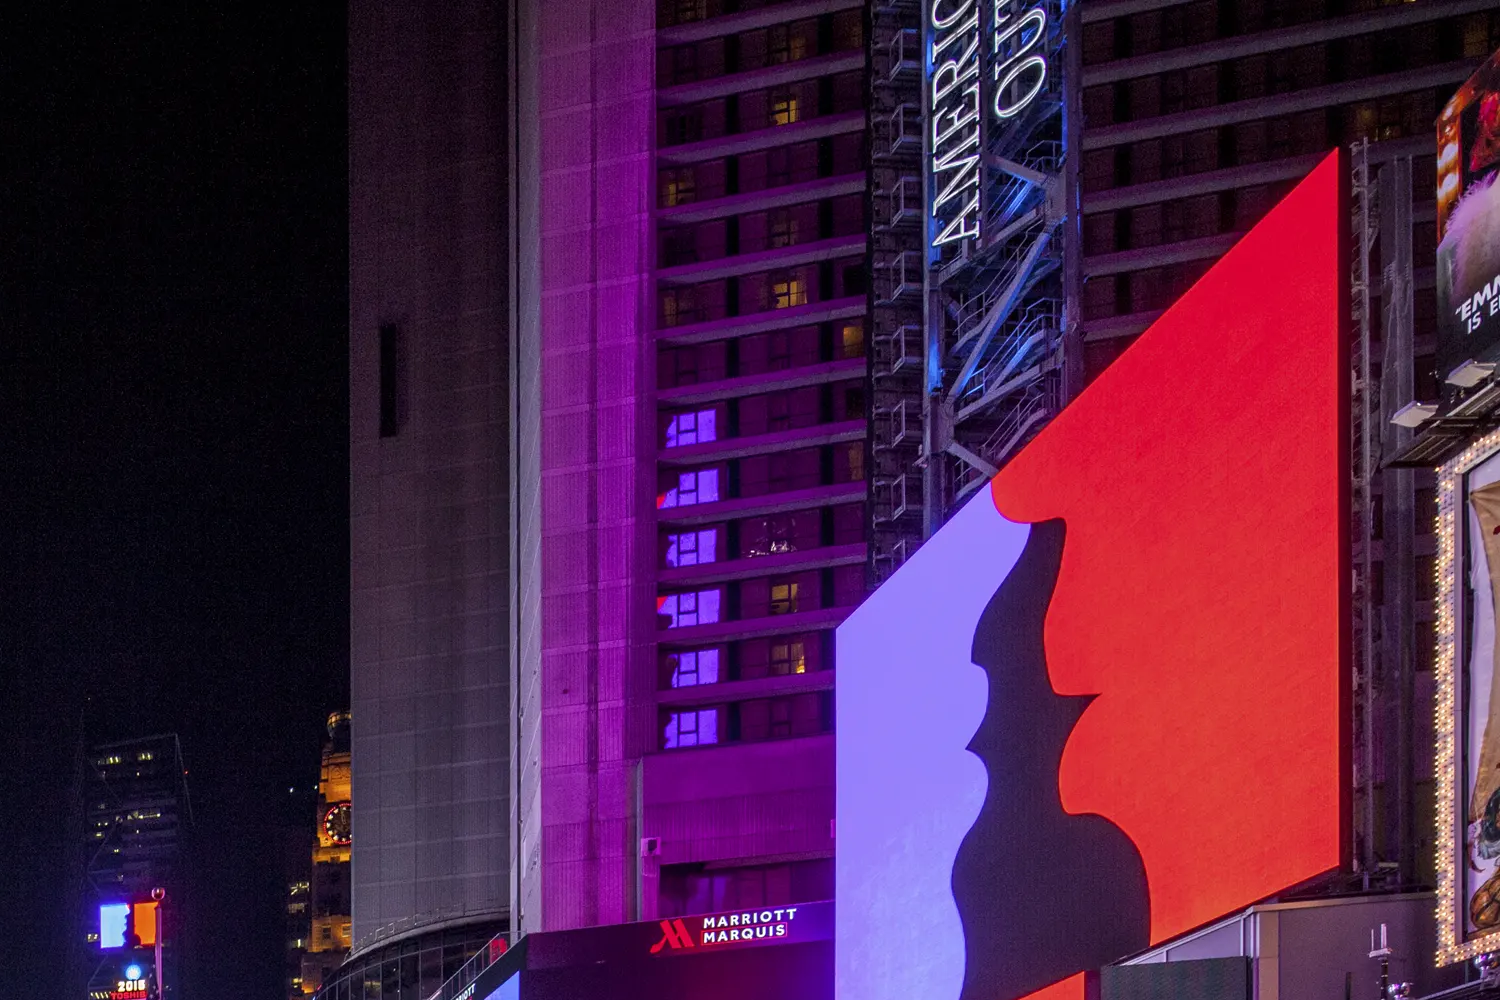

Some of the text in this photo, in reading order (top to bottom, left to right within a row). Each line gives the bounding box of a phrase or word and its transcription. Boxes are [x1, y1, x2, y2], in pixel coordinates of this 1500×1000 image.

[1468, 311, 1482, 335] IS
[703, 908, 797, 929] MARRIOTT
[703, 924, 786, 944] MARQUIS
[117, 980, 146, 992] 2015
